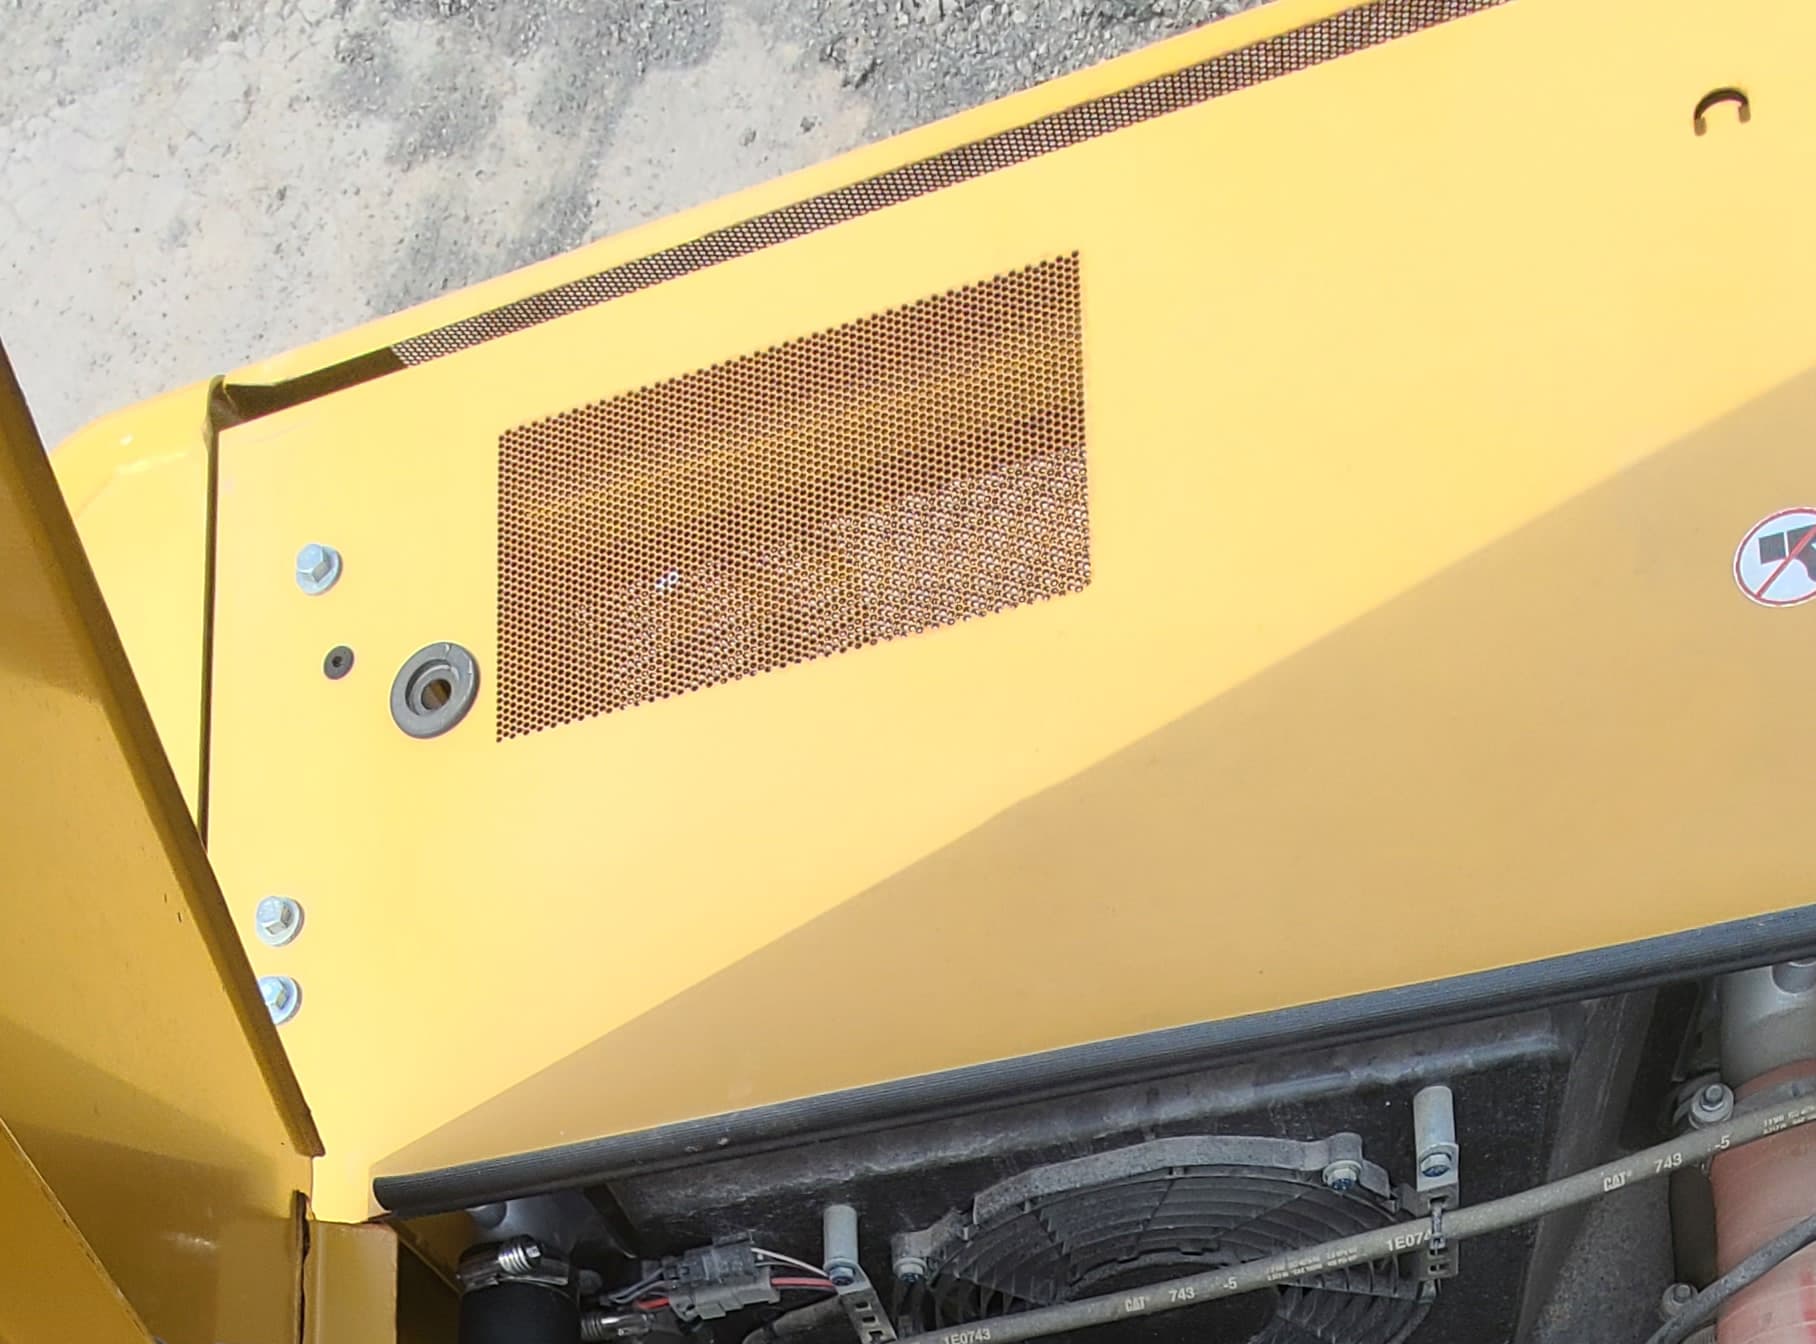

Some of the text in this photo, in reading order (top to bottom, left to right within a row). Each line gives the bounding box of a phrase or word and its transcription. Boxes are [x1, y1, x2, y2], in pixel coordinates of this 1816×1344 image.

[1655, 1152, 1683, 1173] 743
[1714, 1135, 1731, 1150] -5
[1168, 1286, 1195, 1302] 743
[1223, 1277, 1238, 1290] -5
[1385, 1230, 1432, 1252] 1E074
